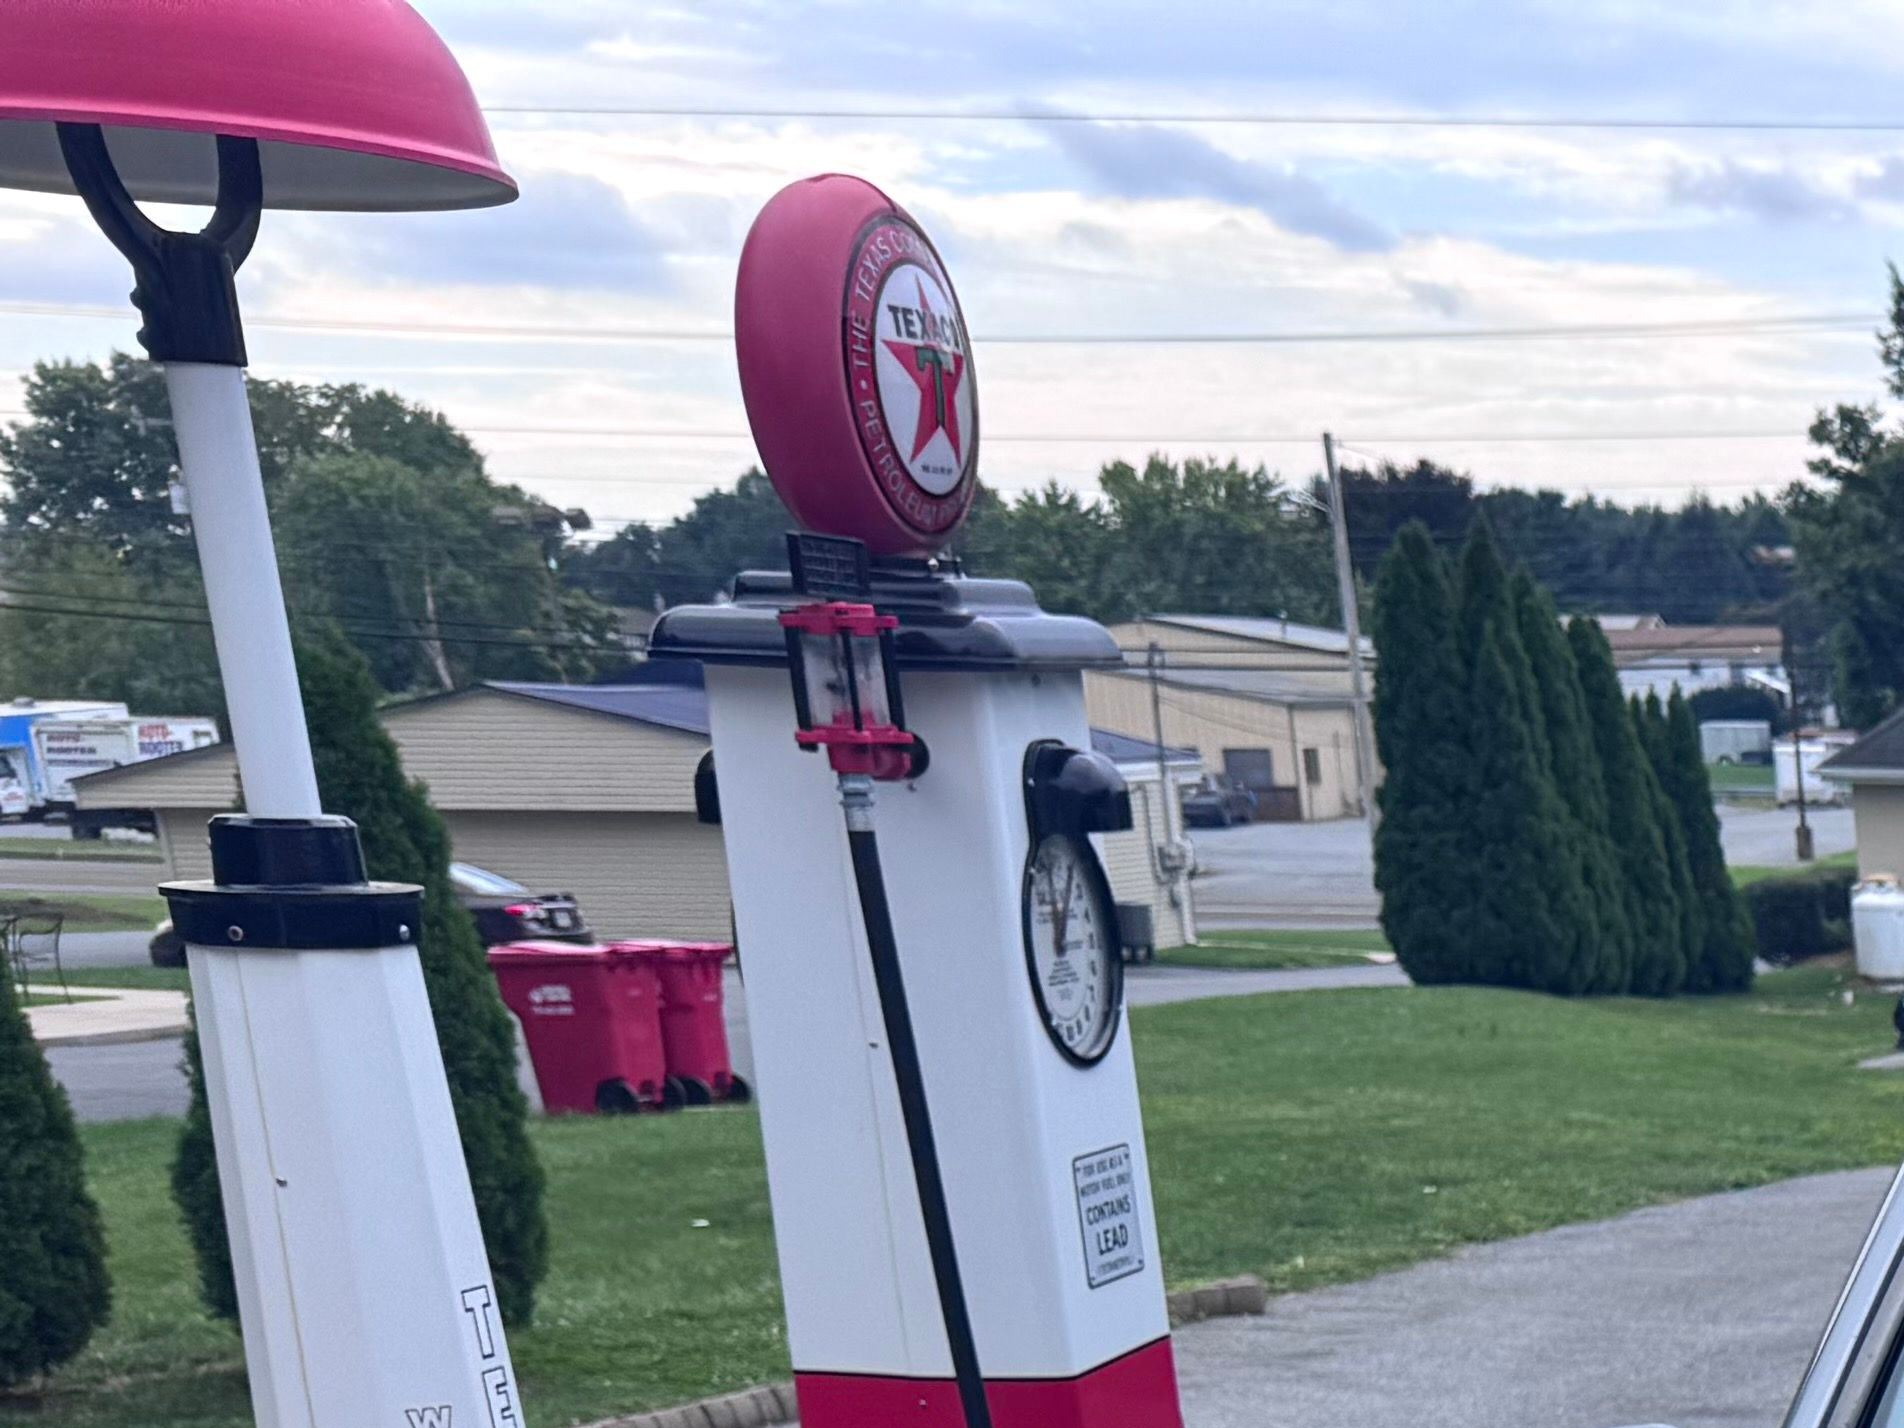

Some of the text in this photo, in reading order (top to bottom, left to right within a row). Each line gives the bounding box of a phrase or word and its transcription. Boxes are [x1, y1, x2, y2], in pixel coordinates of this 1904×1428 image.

[851, 235, 893, 368] THE TEXAS
[1086, 1194, 1131, 1226] CONTAINS
[1096, 1223, 1129, 1255] LEAD
